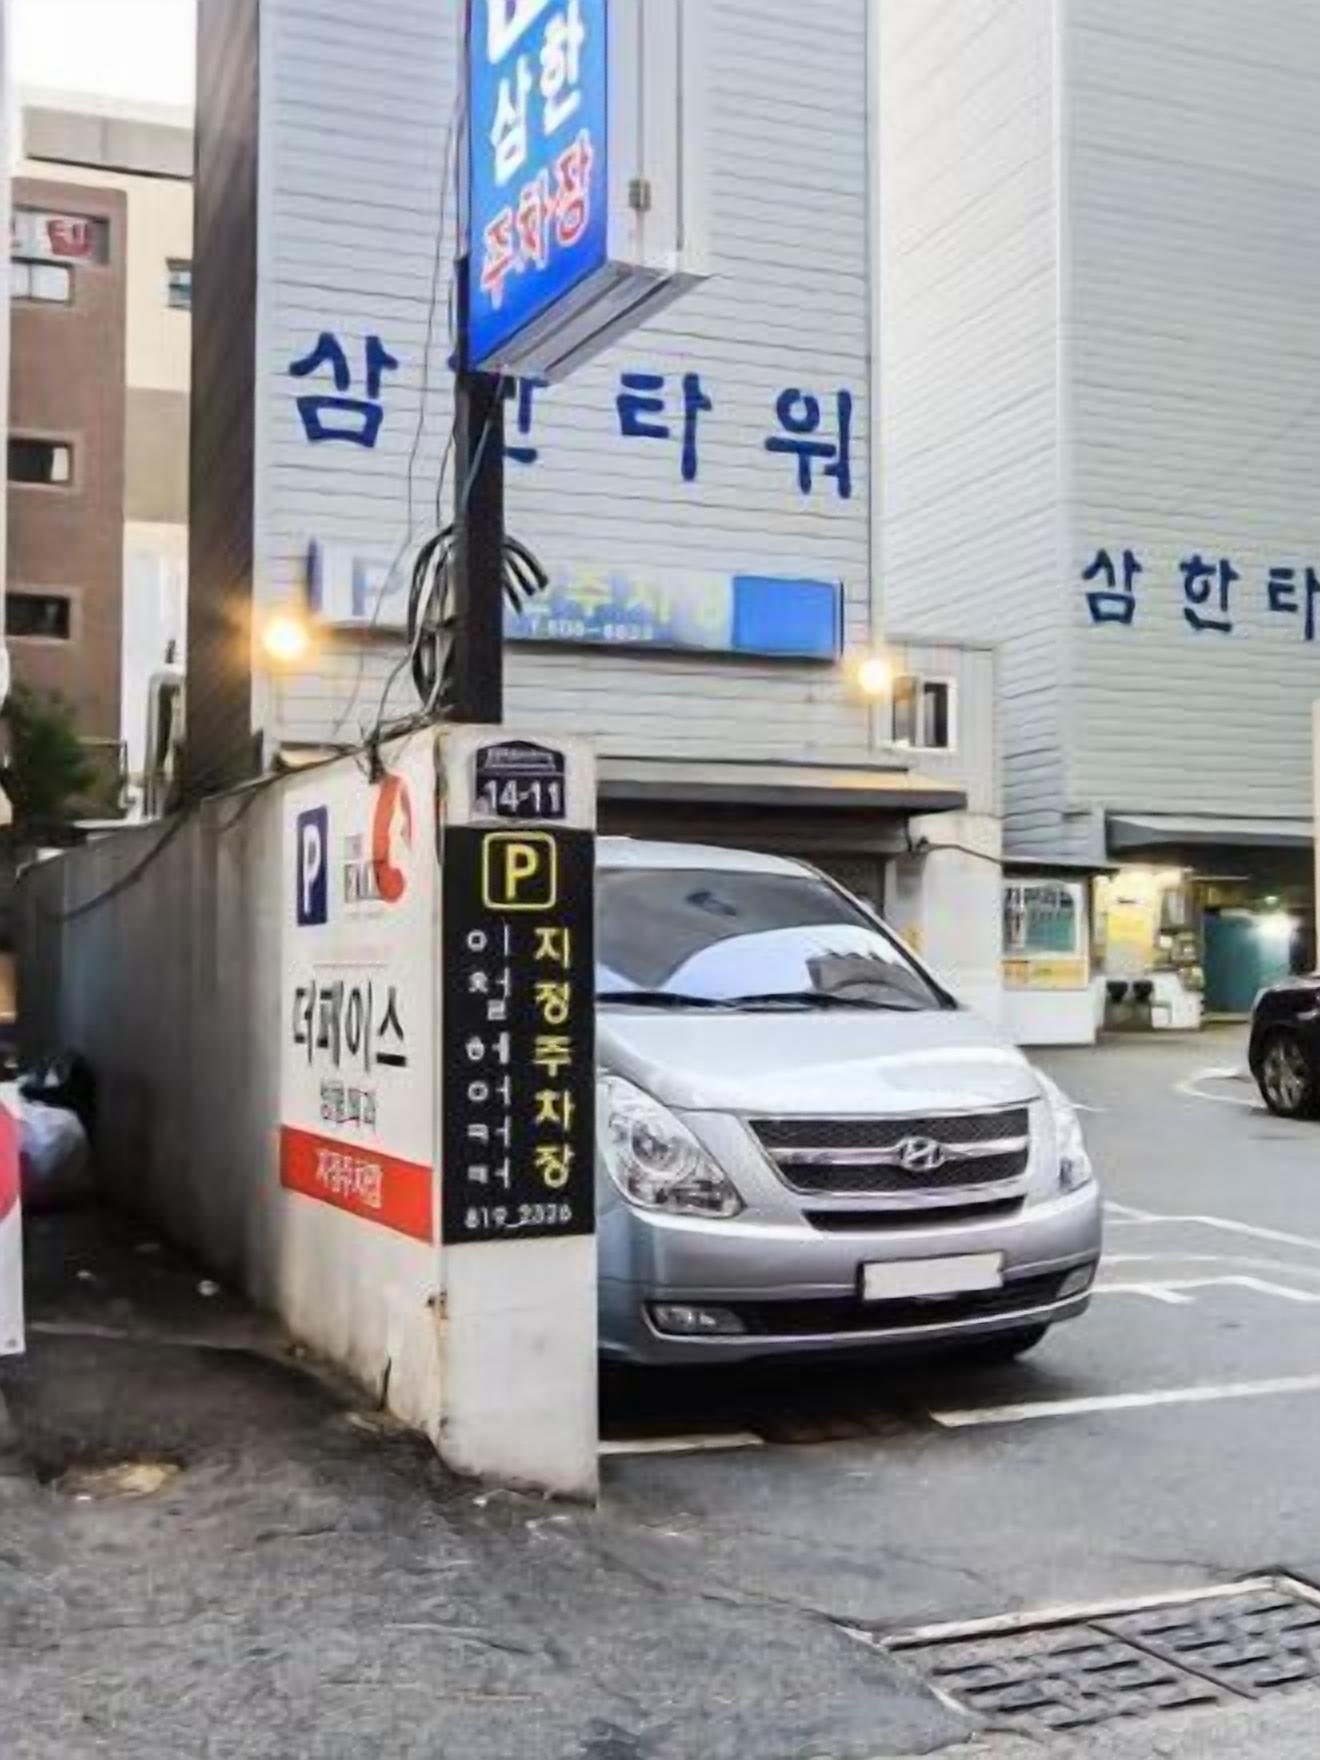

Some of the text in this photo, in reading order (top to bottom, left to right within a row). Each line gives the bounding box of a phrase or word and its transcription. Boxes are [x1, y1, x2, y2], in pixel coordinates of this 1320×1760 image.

[480, 128, 593, 310] 주차장
[484, 779, 562, 814] 14-11
[302, 823, 322, 918] P
[505, 842, 540, 901] P
